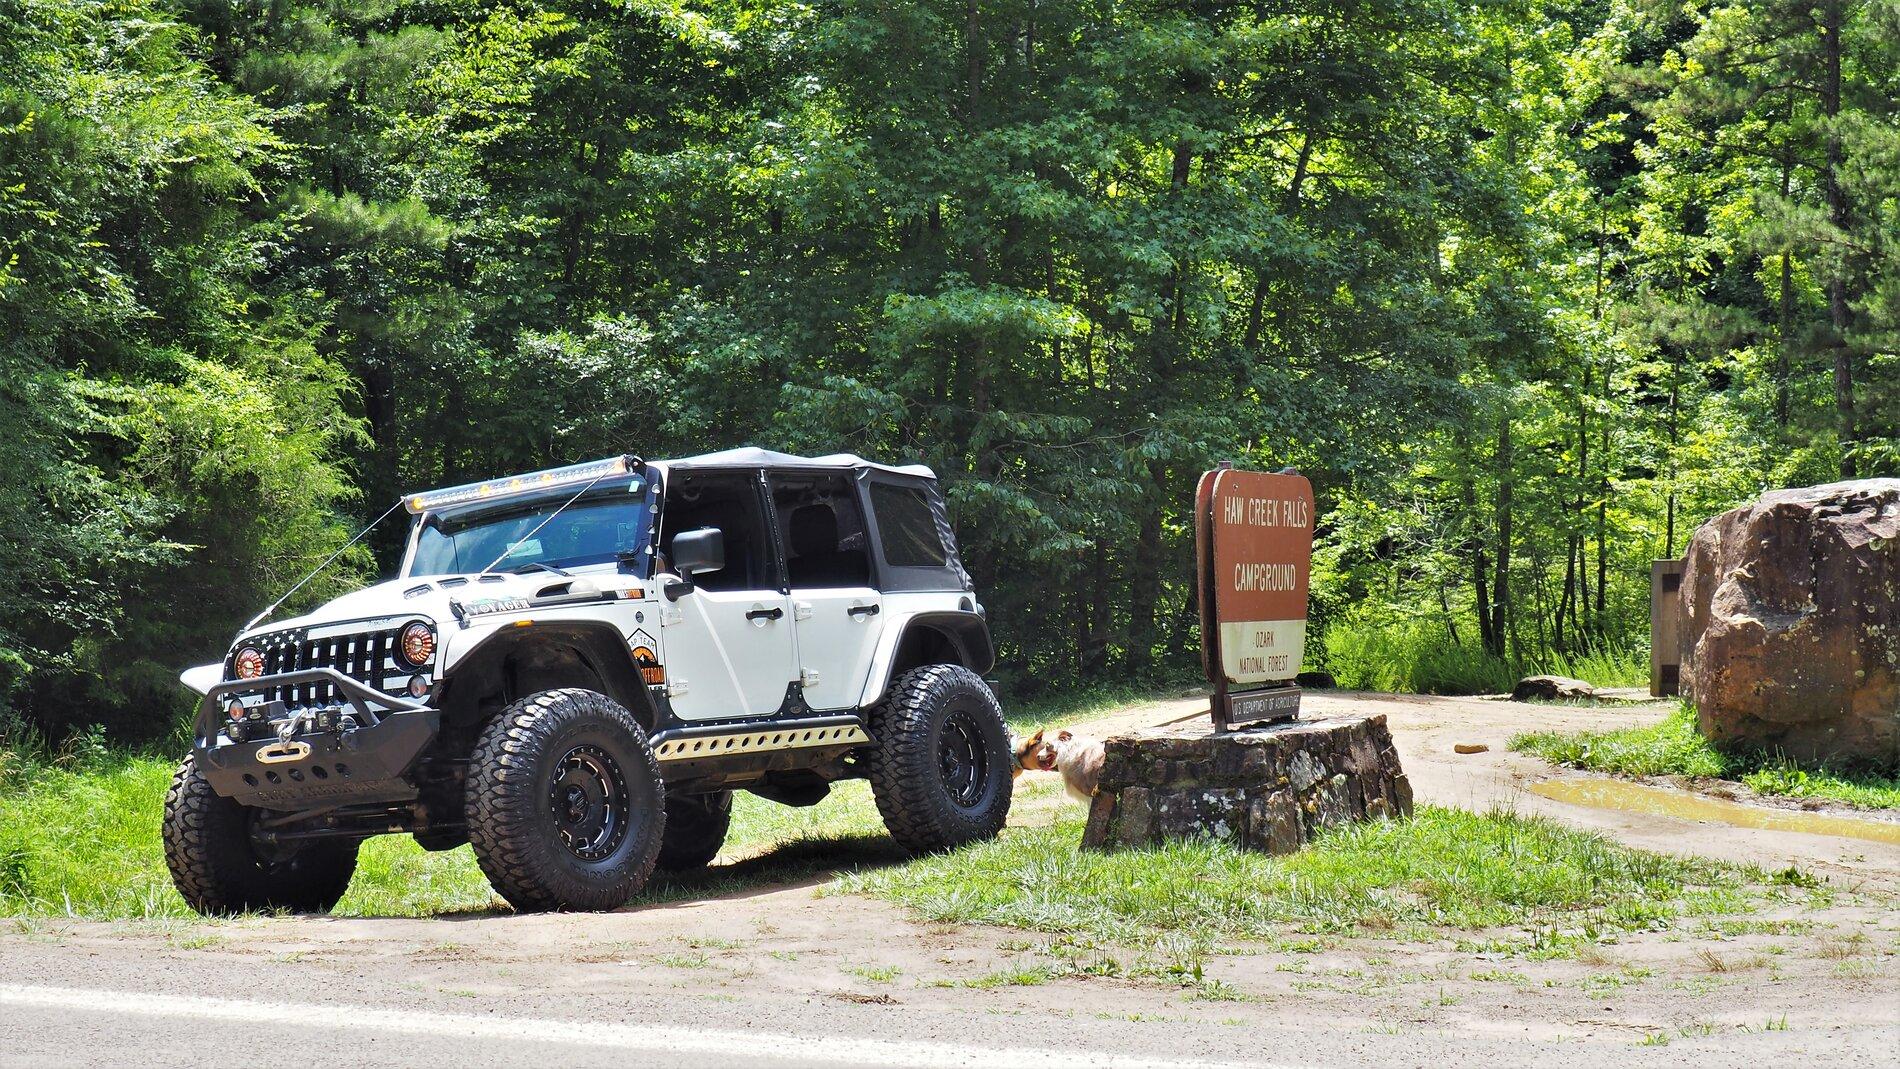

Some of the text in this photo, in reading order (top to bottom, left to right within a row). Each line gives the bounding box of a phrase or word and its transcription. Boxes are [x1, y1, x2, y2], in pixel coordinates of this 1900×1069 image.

[1224, 496, 1307, 528] HAW CREEK FALLS
[1234, 563, 1296, 591] CAMPGROUND
[1256, 631, 1274, 648] OZARK
[1239, 655, 1288, 674] NATIONAL FOREST
